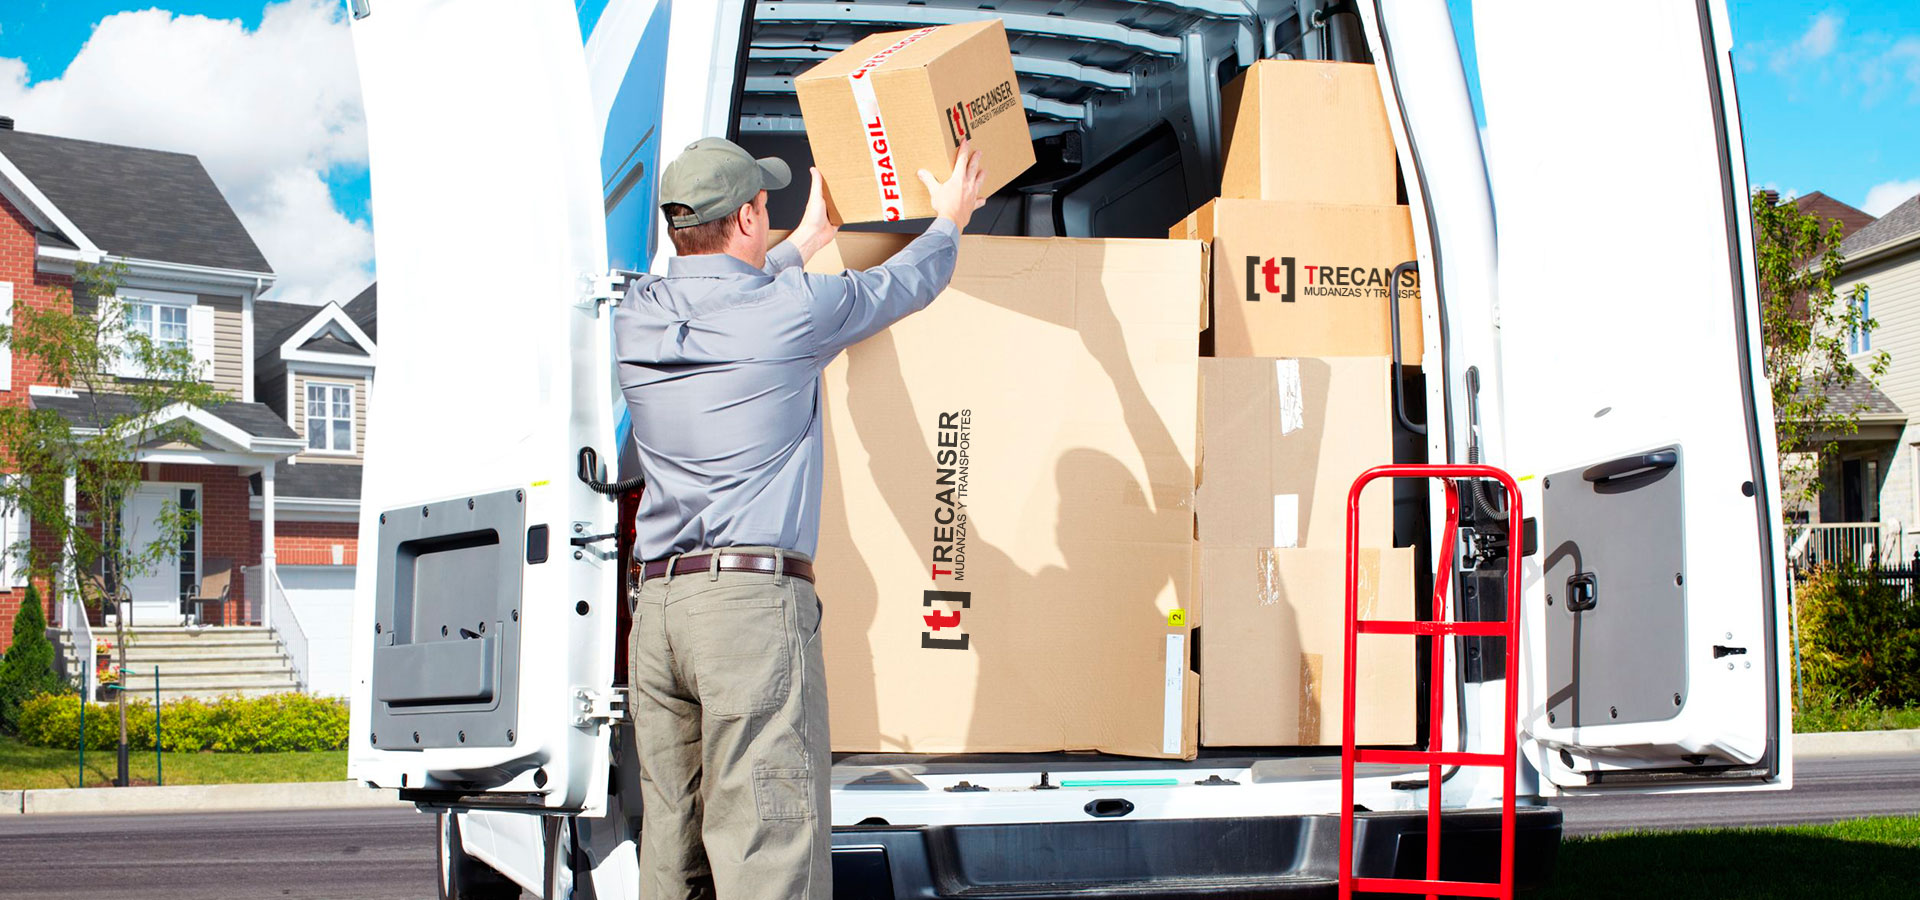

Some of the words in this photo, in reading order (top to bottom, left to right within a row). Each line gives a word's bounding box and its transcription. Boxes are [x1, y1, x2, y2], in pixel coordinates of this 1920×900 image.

[966, 80, 1013, 120] TRECANSER
[868, 116, 899, 200] FRAGIL
[1304, 287, 1362, 297] MUDANZAS
[1364, 289, 1371, 298] Y
[958, 409, 971, 499] TRANSPORTES
[932, 411, 959, 580] TRECANSER
[958, 501, 967, 510] Y
[955, 513, 967, 581] MUDANZAS
